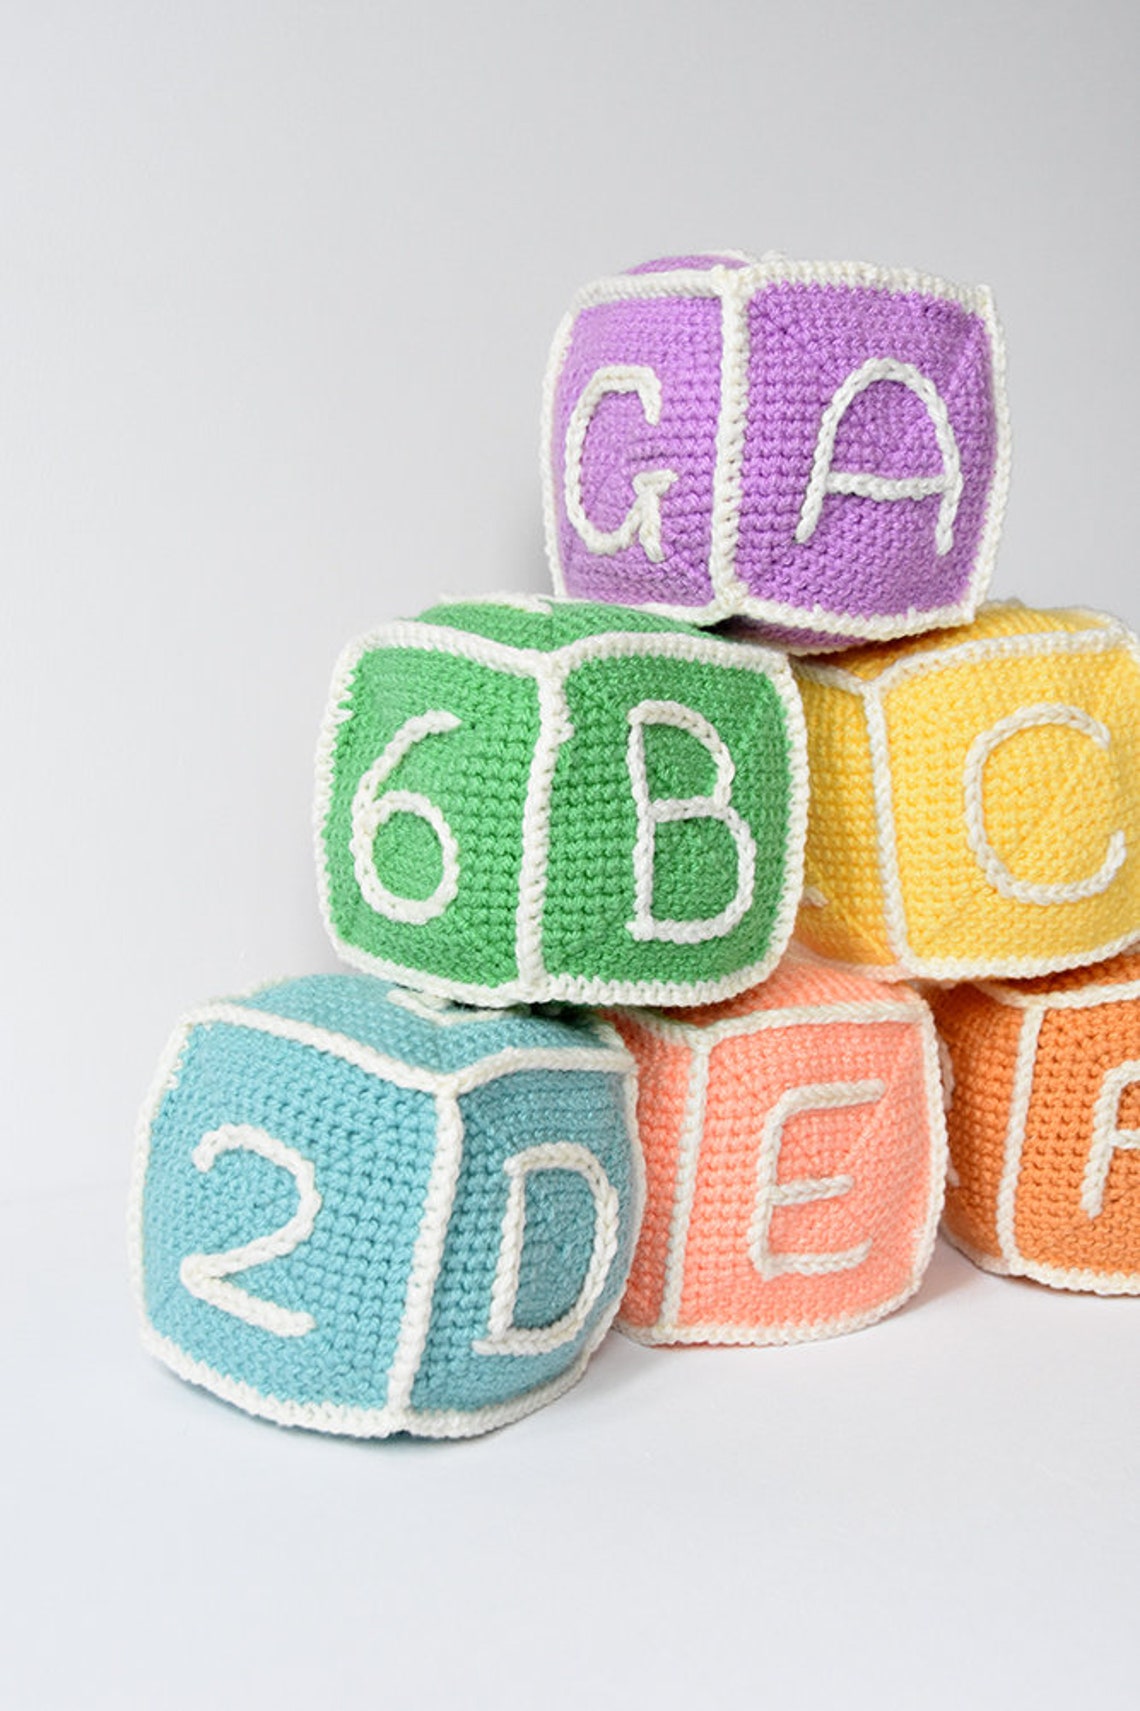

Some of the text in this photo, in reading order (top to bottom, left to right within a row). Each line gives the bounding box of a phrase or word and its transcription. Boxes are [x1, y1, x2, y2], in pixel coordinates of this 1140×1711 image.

[565, 365, 678, 563] G
[795, 358, 963, 556] A
[350, 709, 462, 925] 6
[626, 699, 757, 943] B
[962, 702, 1127, 906] C
[179, 1123, 323, 1338] 2
[472, 1141, 619, 1357] D
[748, 1078, 886, 1282] E
